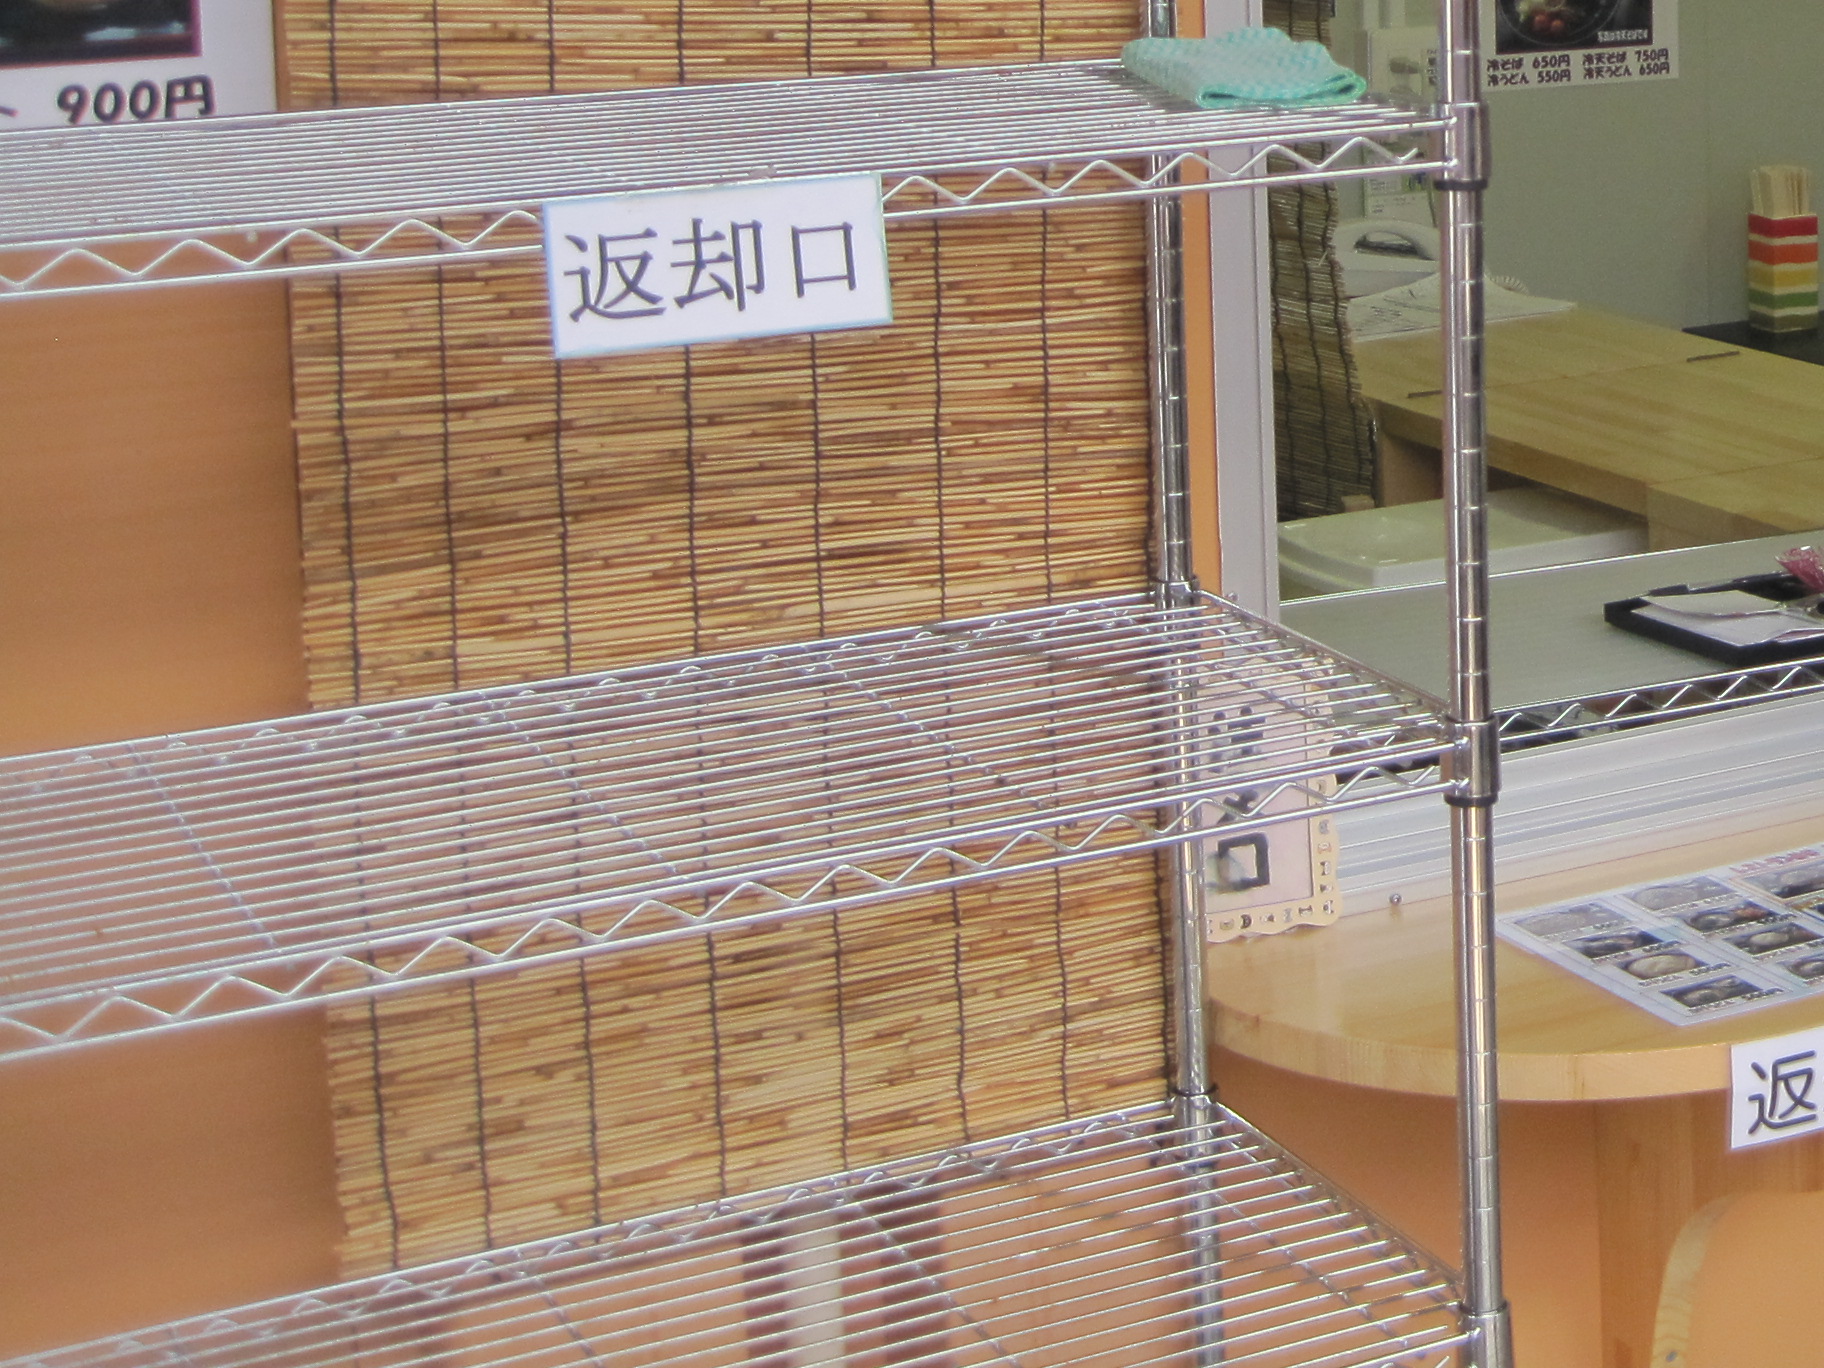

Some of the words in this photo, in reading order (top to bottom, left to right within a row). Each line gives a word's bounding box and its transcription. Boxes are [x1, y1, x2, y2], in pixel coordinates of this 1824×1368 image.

[1486, 56, 1524, 72] 冷そば
[1531, 53, 1572, 70] 650円
[1582, 50, 1628, 67] 冷天そば
[1634, 47, 1670, 63] 750円
[1487, 72, 1531, 87] 冷うどん
[1537, 68, 1572, 84] 550円
[1583, 64, 1633, 80] 冷天うどん
[1638, 61, 1671, 77] 650円
[57, 73, 216, 125] 900円
[563, 216, 860, 325] 返却口
